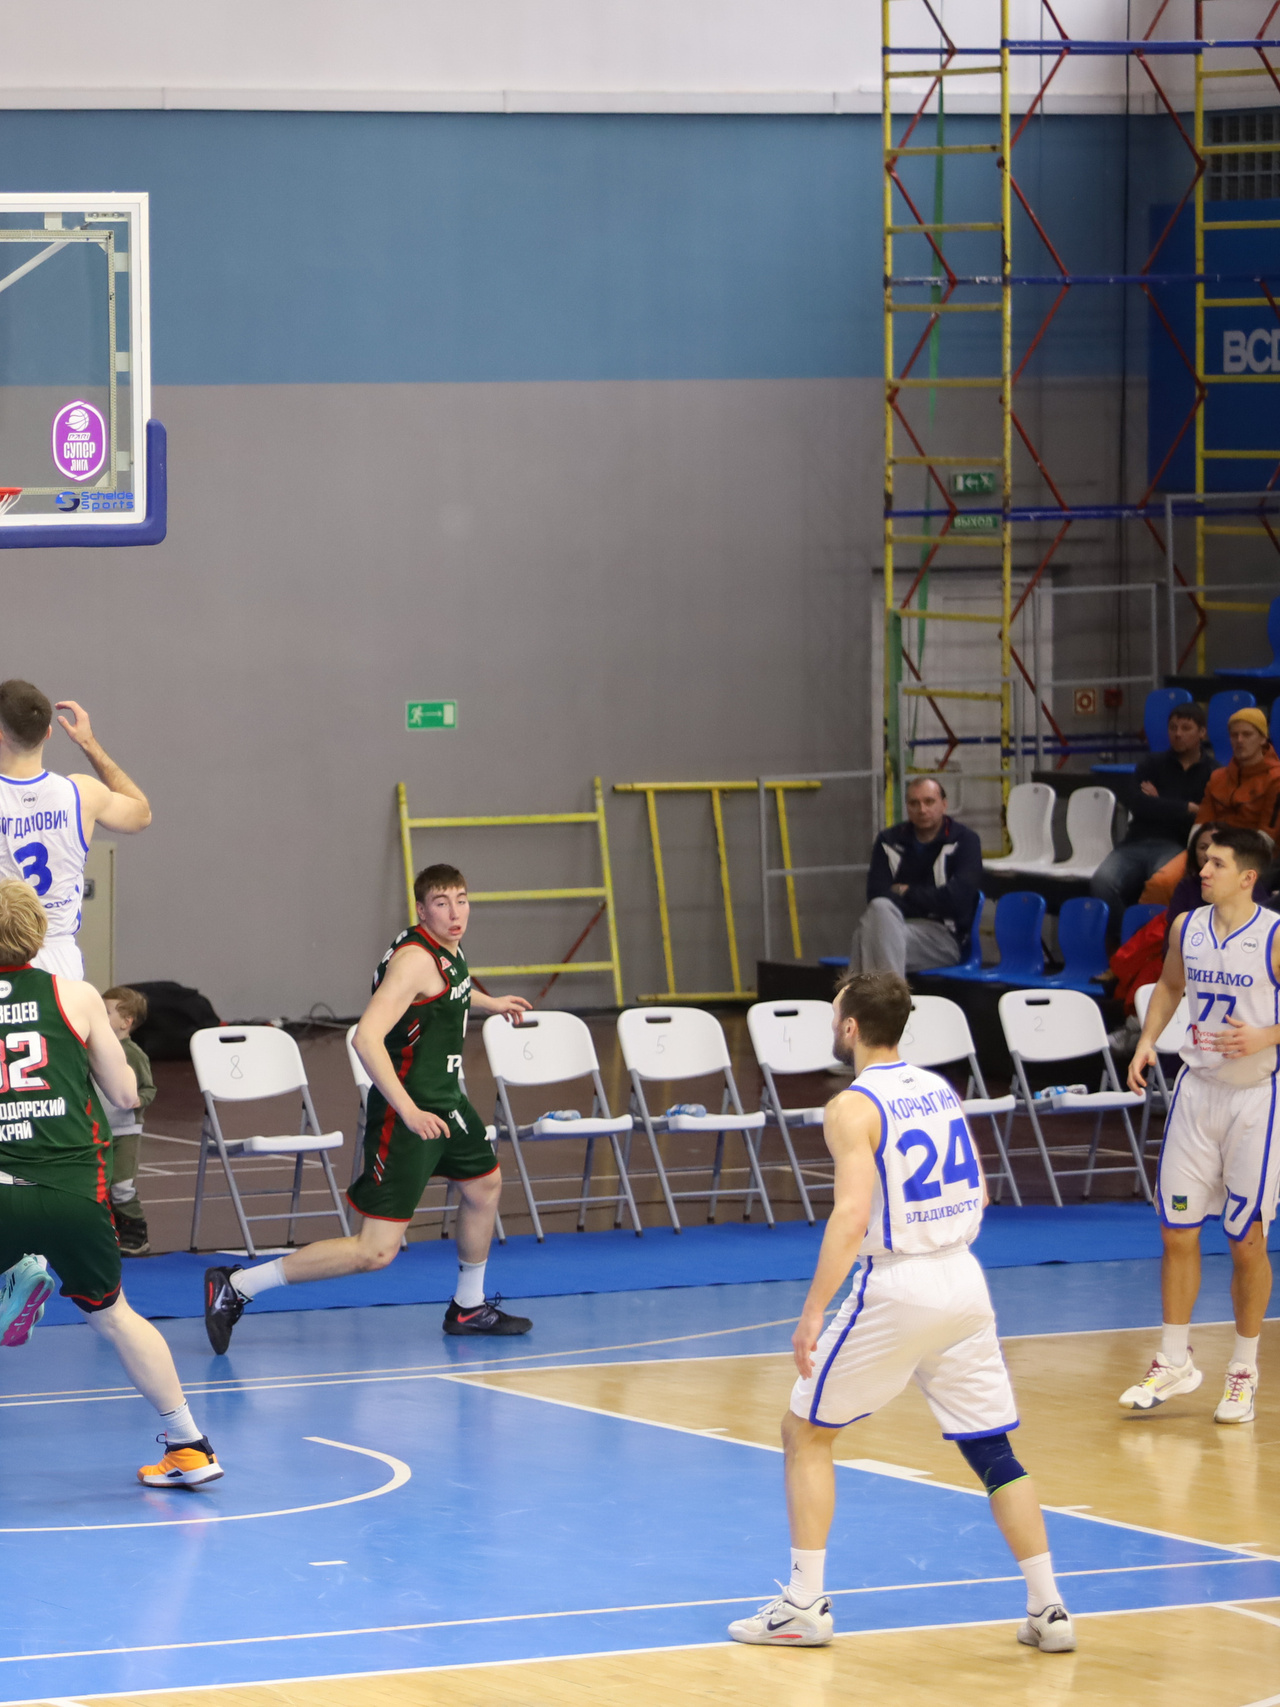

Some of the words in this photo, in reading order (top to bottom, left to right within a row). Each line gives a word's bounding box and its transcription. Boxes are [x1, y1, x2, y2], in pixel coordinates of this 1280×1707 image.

[63, 441, 96, 459] СУПЕР
[70, 459, 89, 472] ЛИГА
[81, 491, 134, 500] Schelde
[81, 501, 134, 511] Sports
[13, 842, 53, 897] 3
[1187, 966, 1254, 987] ДИНАМО
[1197, 991, 1237, 1024] 77
[656, 1034, 668, 1054] 5
[782, 1026, 793, 1053] 4
[522, 1040, 534, 1061] 6
[229, 1055, 244, 1080] 8
[895, 1117, 980, 1203] 24
